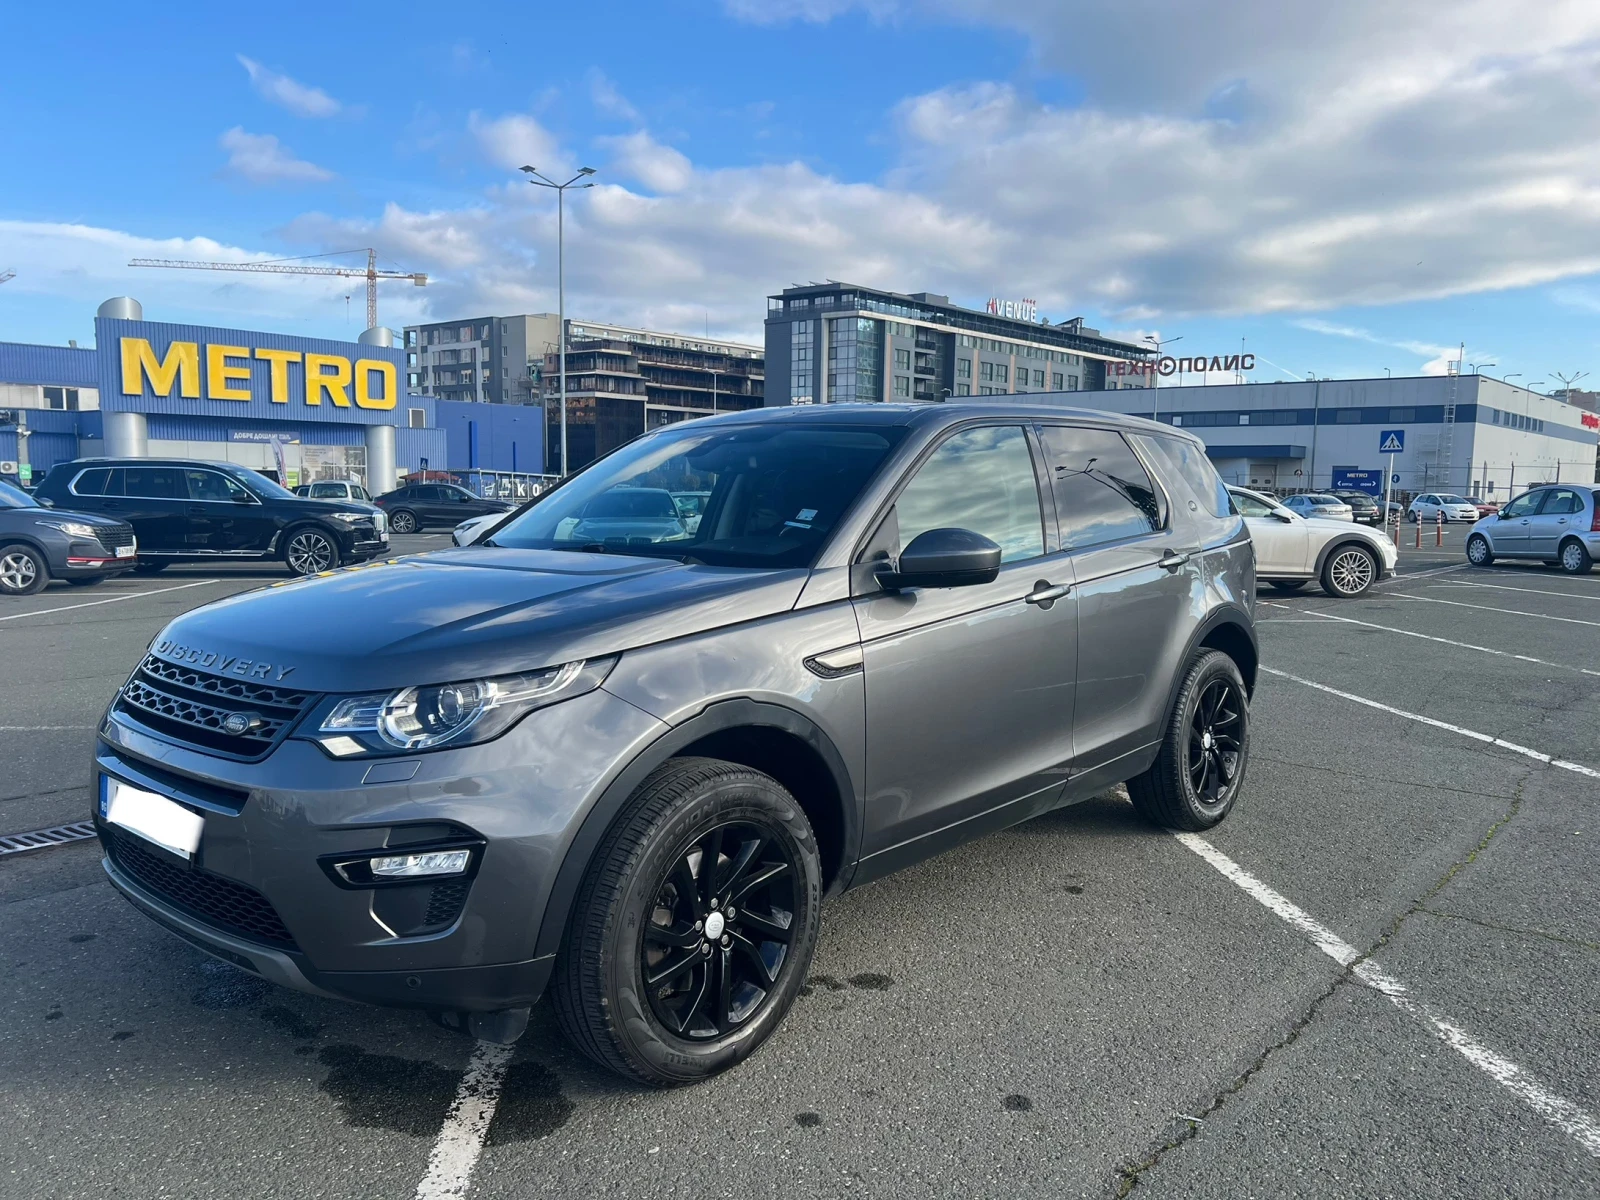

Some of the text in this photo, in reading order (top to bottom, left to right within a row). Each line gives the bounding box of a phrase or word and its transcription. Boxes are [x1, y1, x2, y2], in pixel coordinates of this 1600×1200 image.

[987, 297, 1037, 323] AVENUE
[120, 337, 397, 411] METRO
[1104, 354, 1255, 377] ТЕХНОПОЛИС
[233, 432, 253, 440] ДОБРЕ
[157, 640, 297, 682] DISCOVERY
